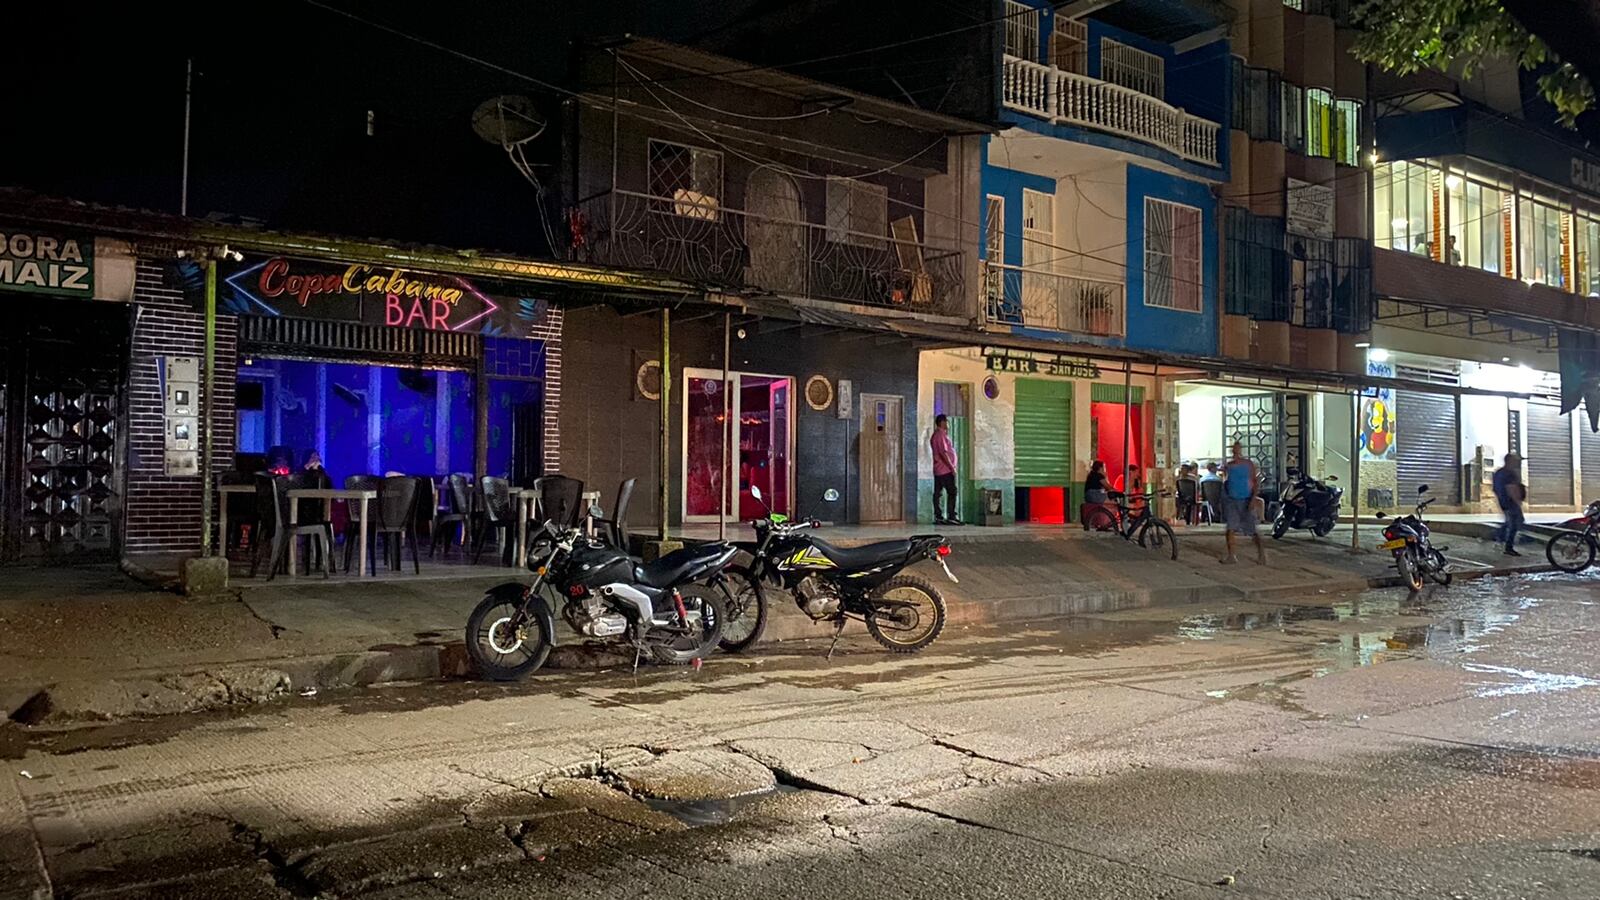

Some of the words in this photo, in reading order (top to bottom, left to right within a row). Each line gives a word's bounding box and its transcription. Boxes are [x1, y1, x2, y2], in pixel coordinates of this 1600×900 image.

[258, 256, 463, 307] CopaCabana
[386, 294, 450, 330] BAR
[992, 355, 1030, 372] BAR
[1052, 360, 1071, 375] SAN
